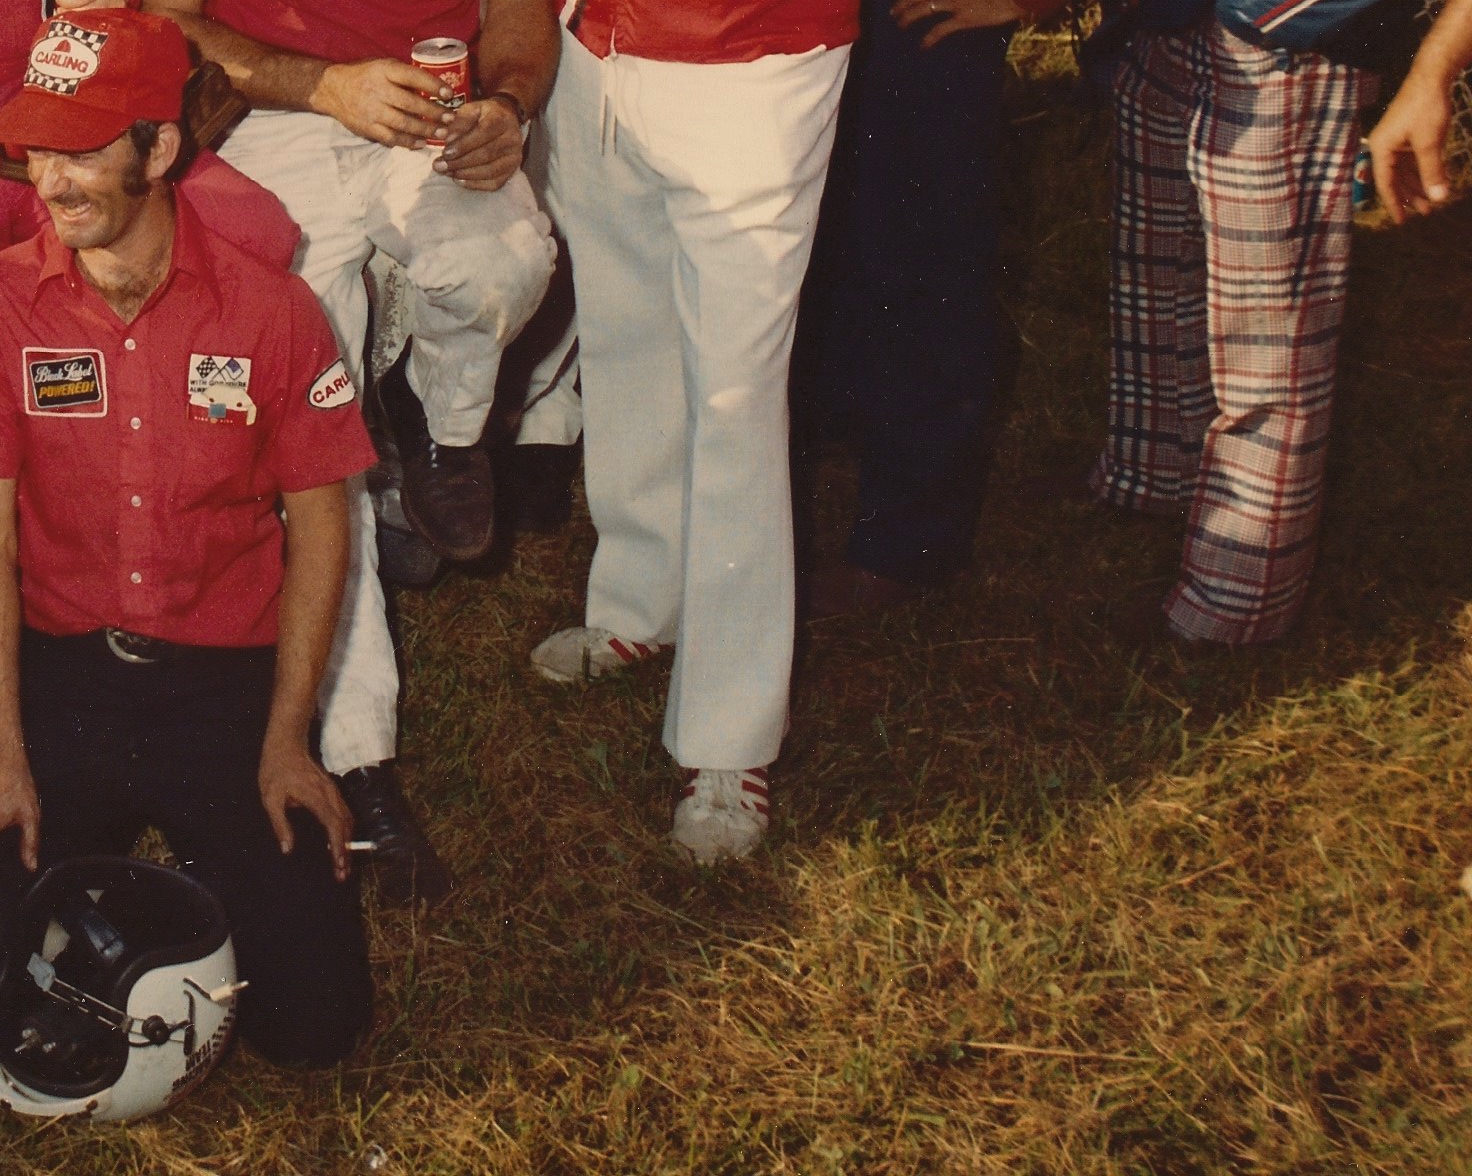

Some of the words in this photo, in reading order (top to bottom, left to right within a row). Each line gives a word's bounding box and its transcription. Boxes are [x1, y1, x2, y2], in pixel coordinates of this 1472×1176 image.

[35, 51, 89, 74] CARLING
[34, 365, 64, 383] Black
[64, 361, 93, 382] Label
[38, 380, 96, 399] POWERED!
[312, 370, 351, 404] CARLI
